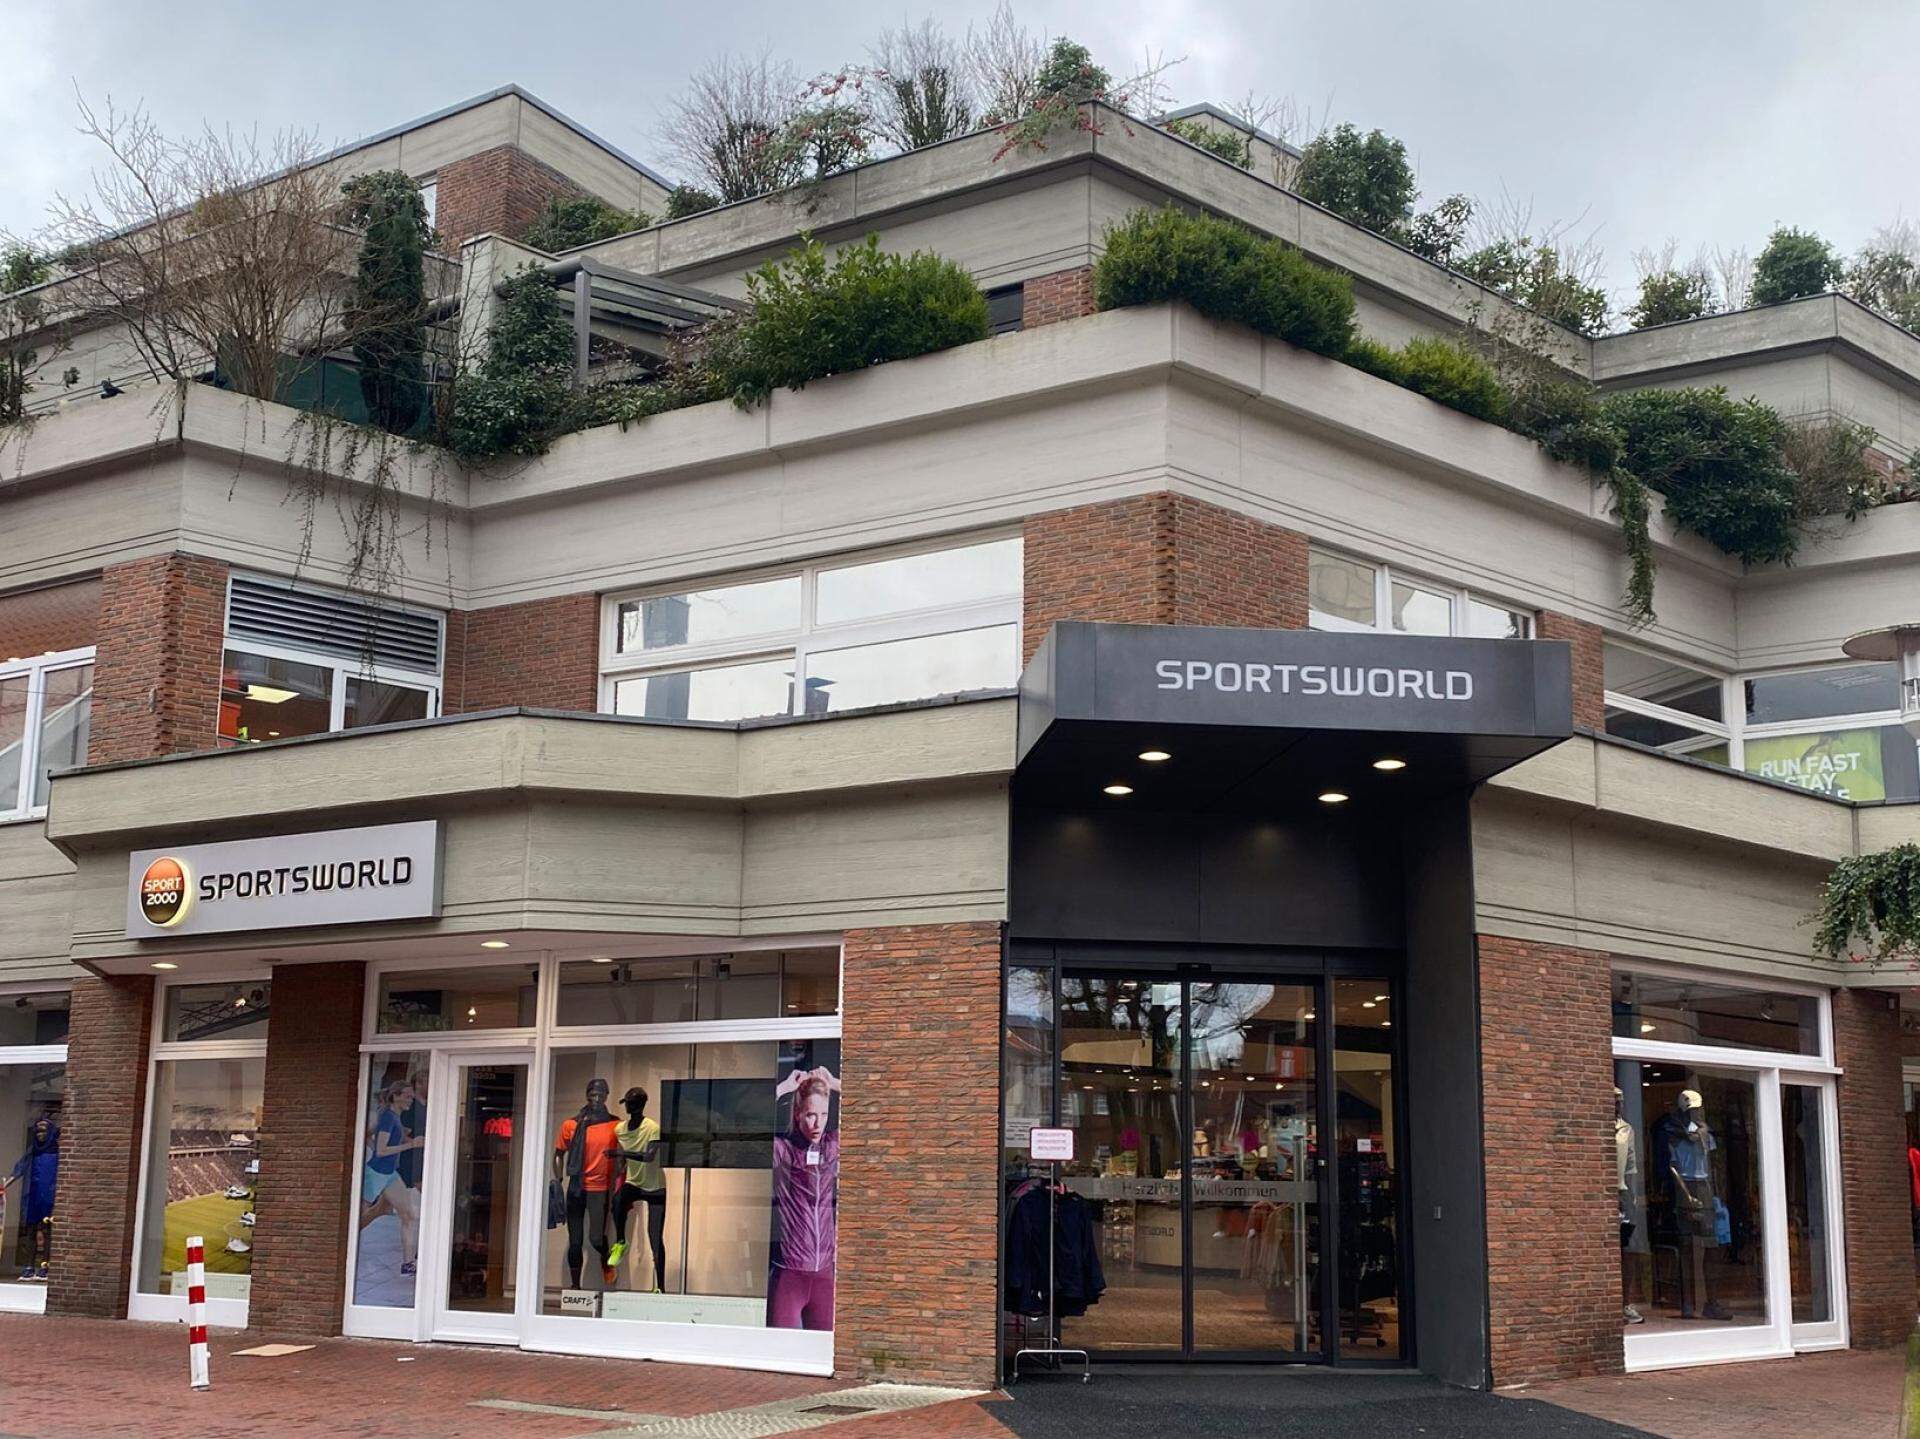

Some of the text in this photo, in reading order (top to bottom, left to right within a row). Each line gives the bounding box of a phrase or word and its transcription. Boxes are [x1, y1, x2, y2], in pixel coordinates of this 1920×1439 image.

[1155, 659, 1474, 701] SPORTSWORLD
[1760, 752, 1861, 777] RUN FAST
[144, 876, 182, 892] SPORT
[199, 856, 412, 901] SPORTSWORLD
[146, 891, 178, 906] 2000
[1193, 1182, 1278, 1198] Willkommen
[562, 1296, 587, 1304] CRAFT
